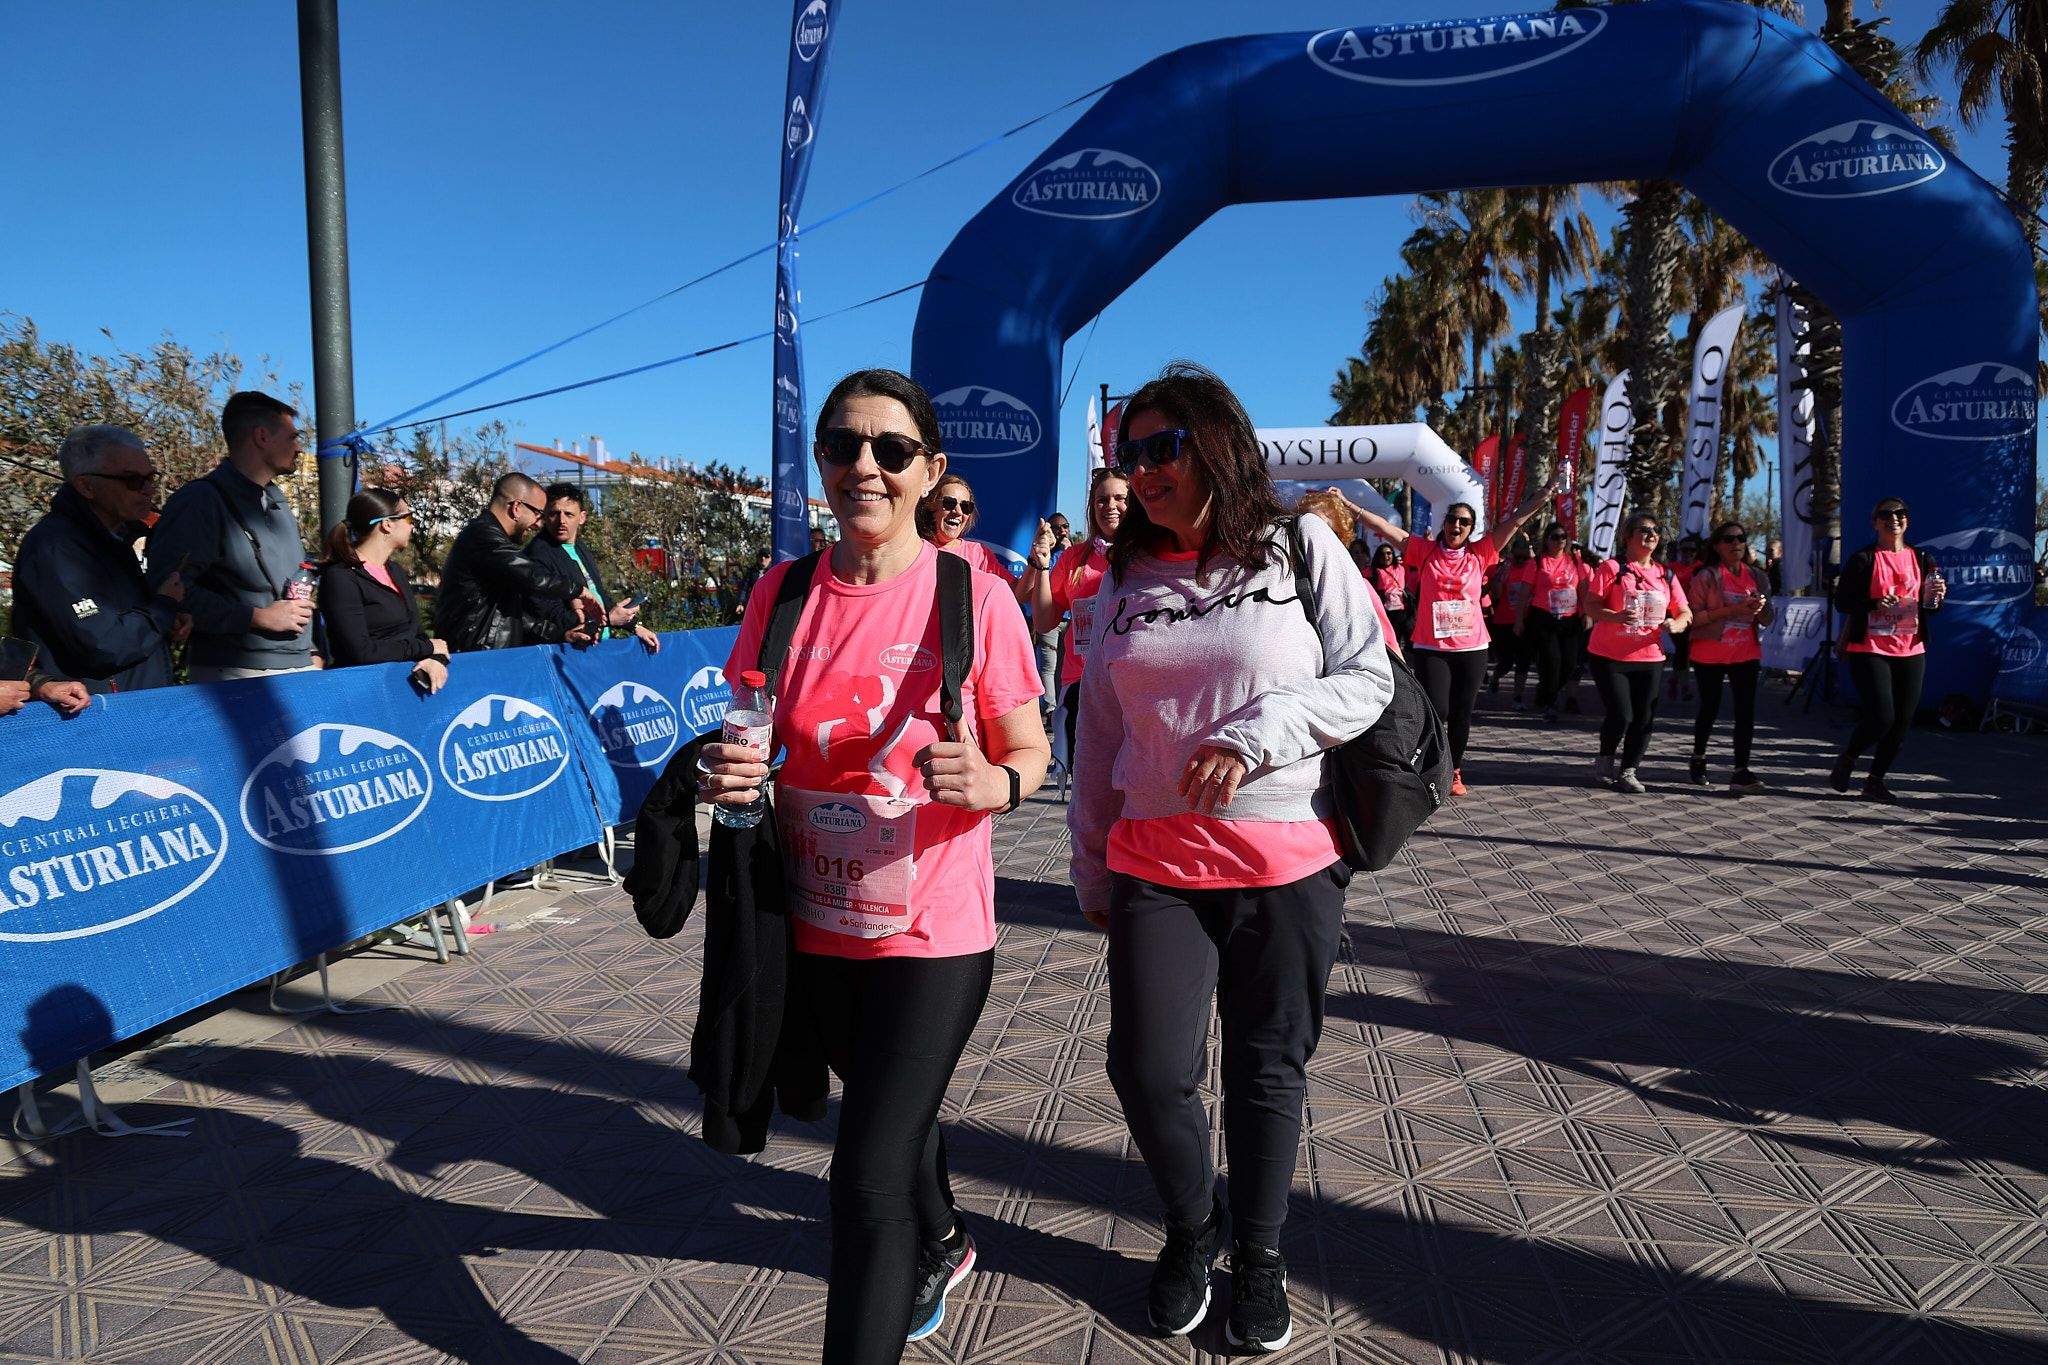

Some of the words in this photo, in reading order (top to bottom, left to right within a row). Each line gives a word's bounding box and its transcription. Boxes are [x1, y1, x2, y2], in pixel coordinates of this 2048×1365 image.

[1330, 14, 1586, 62] ASTURIANA
[1813, 144, 1872, 158] CENTRAL
[1045, 170, 1093, 181] CENTRAL
[1097, 170, 1145, 179] LECHERA
[1782, 153, 1938, 185] ASTURIANA
[1022, 180, 1149, 202] ASTURIANA
[1934, 388, 1993, 399] CENTRAL
[1905, 395, 2034, 424] ASTURIAN
[1417, 464, 1461, 475] OYSHO
[1593, 401, 1632, 552] OYSHO
[1943, 565, 2032, 585] TURIANA
[788, 646, 831, 661] YSHO
[883, 653, 933, 667] ASTURIANA
[467, 730, 511, 747] CENTRAL
[512, 721, 551, 737] LECHERA
[598, 715, 675, 752] ASTURIANA
[284, 766, 347, 789] CENTRAL
[350, 752, 409, 774] LECHERA
[453, 735, 564, 785] ASTURIANA
[263, 768, 425, 838] ASTURIANA
[2, 823, 99, 857] CENTRAL
[106, 802, 193, 833] LECHERA
[812, 811, 862, 828] ASTURIANA
[815, 854, 864, 881] 016
[824, 883, 847, 896] 8380
[832, 898, 853, 909] MUJER
[858, 902, 890, 914] VALENCIA
